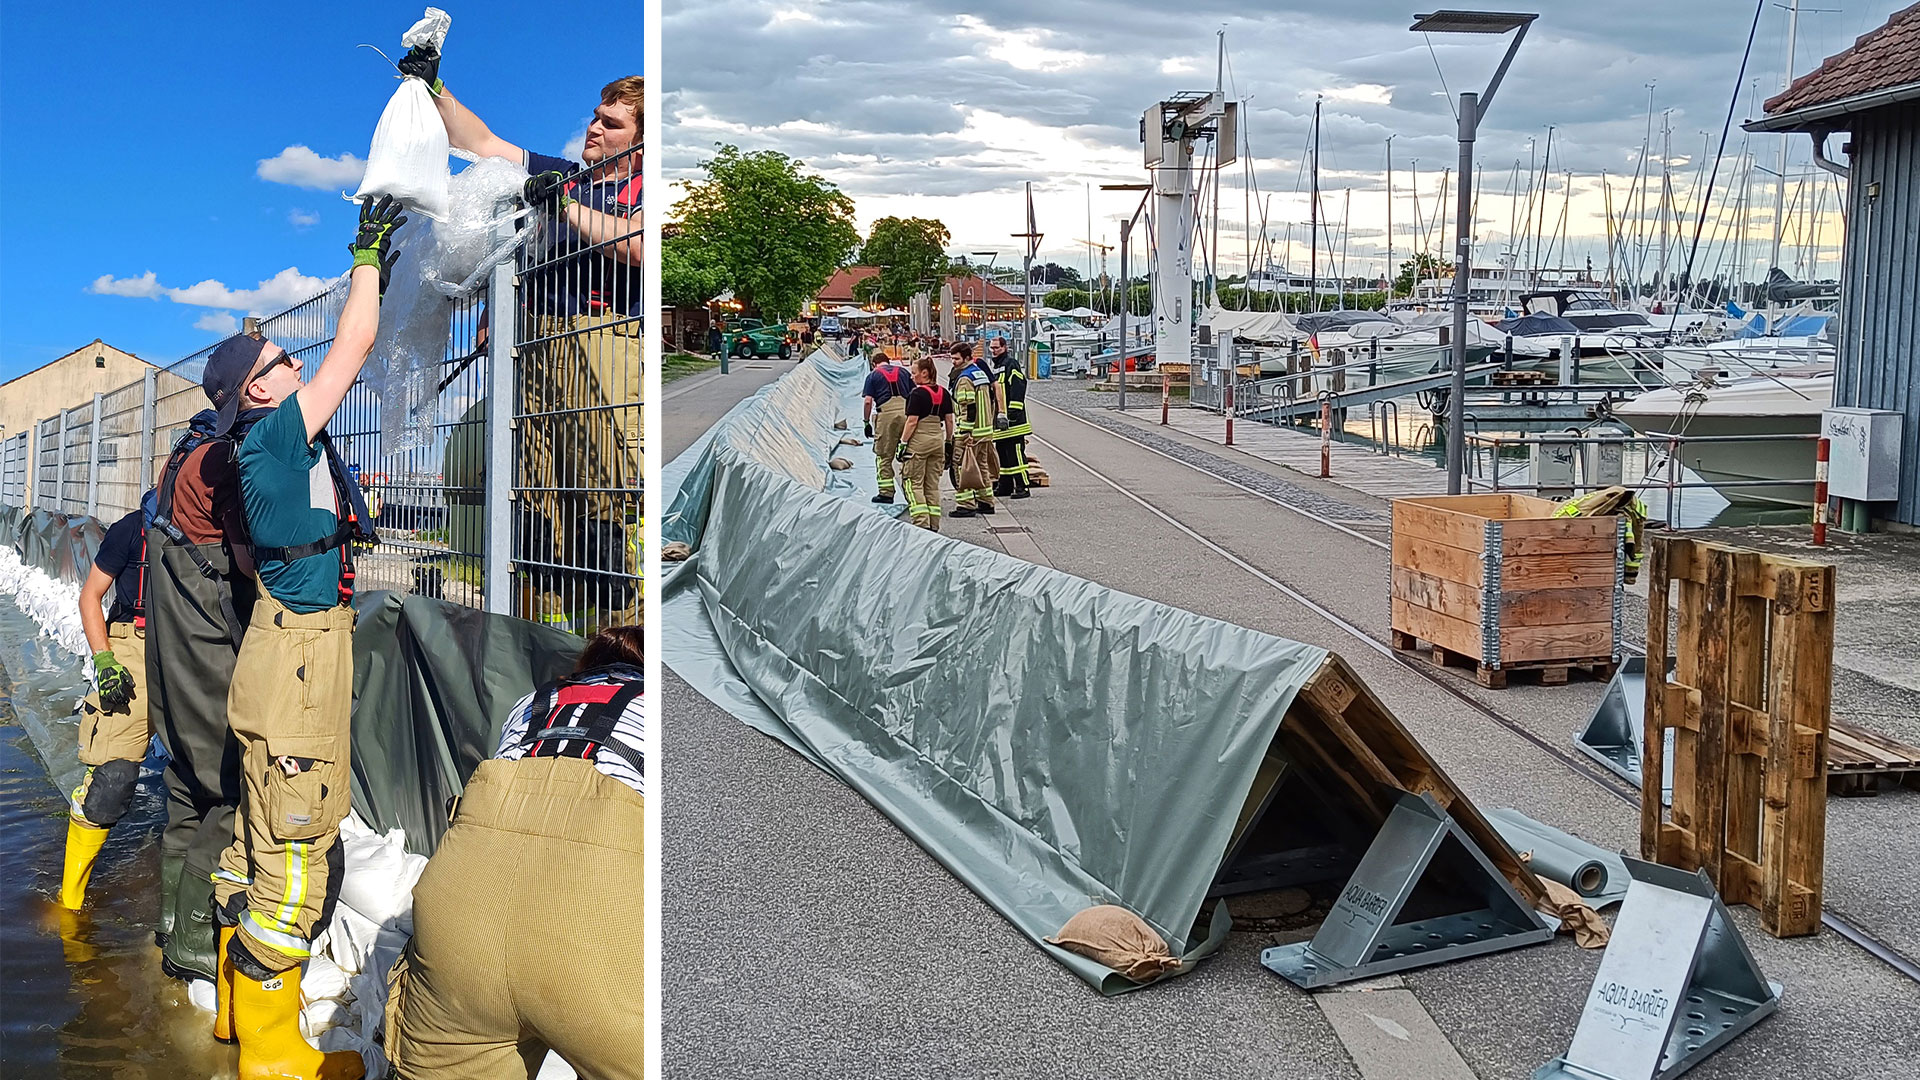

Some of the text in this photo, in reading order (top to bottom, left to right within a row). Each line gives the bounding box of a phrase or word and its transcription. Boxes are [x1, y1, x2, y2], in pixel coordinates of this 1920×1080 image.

[1343, 884, 1366, 905] AQUA
[1359, 891, 1388, 917] BARRIER
[1597, 982, 1629, 1007] AQUA
[1628, 989, 1669, 1019] BARRIER
